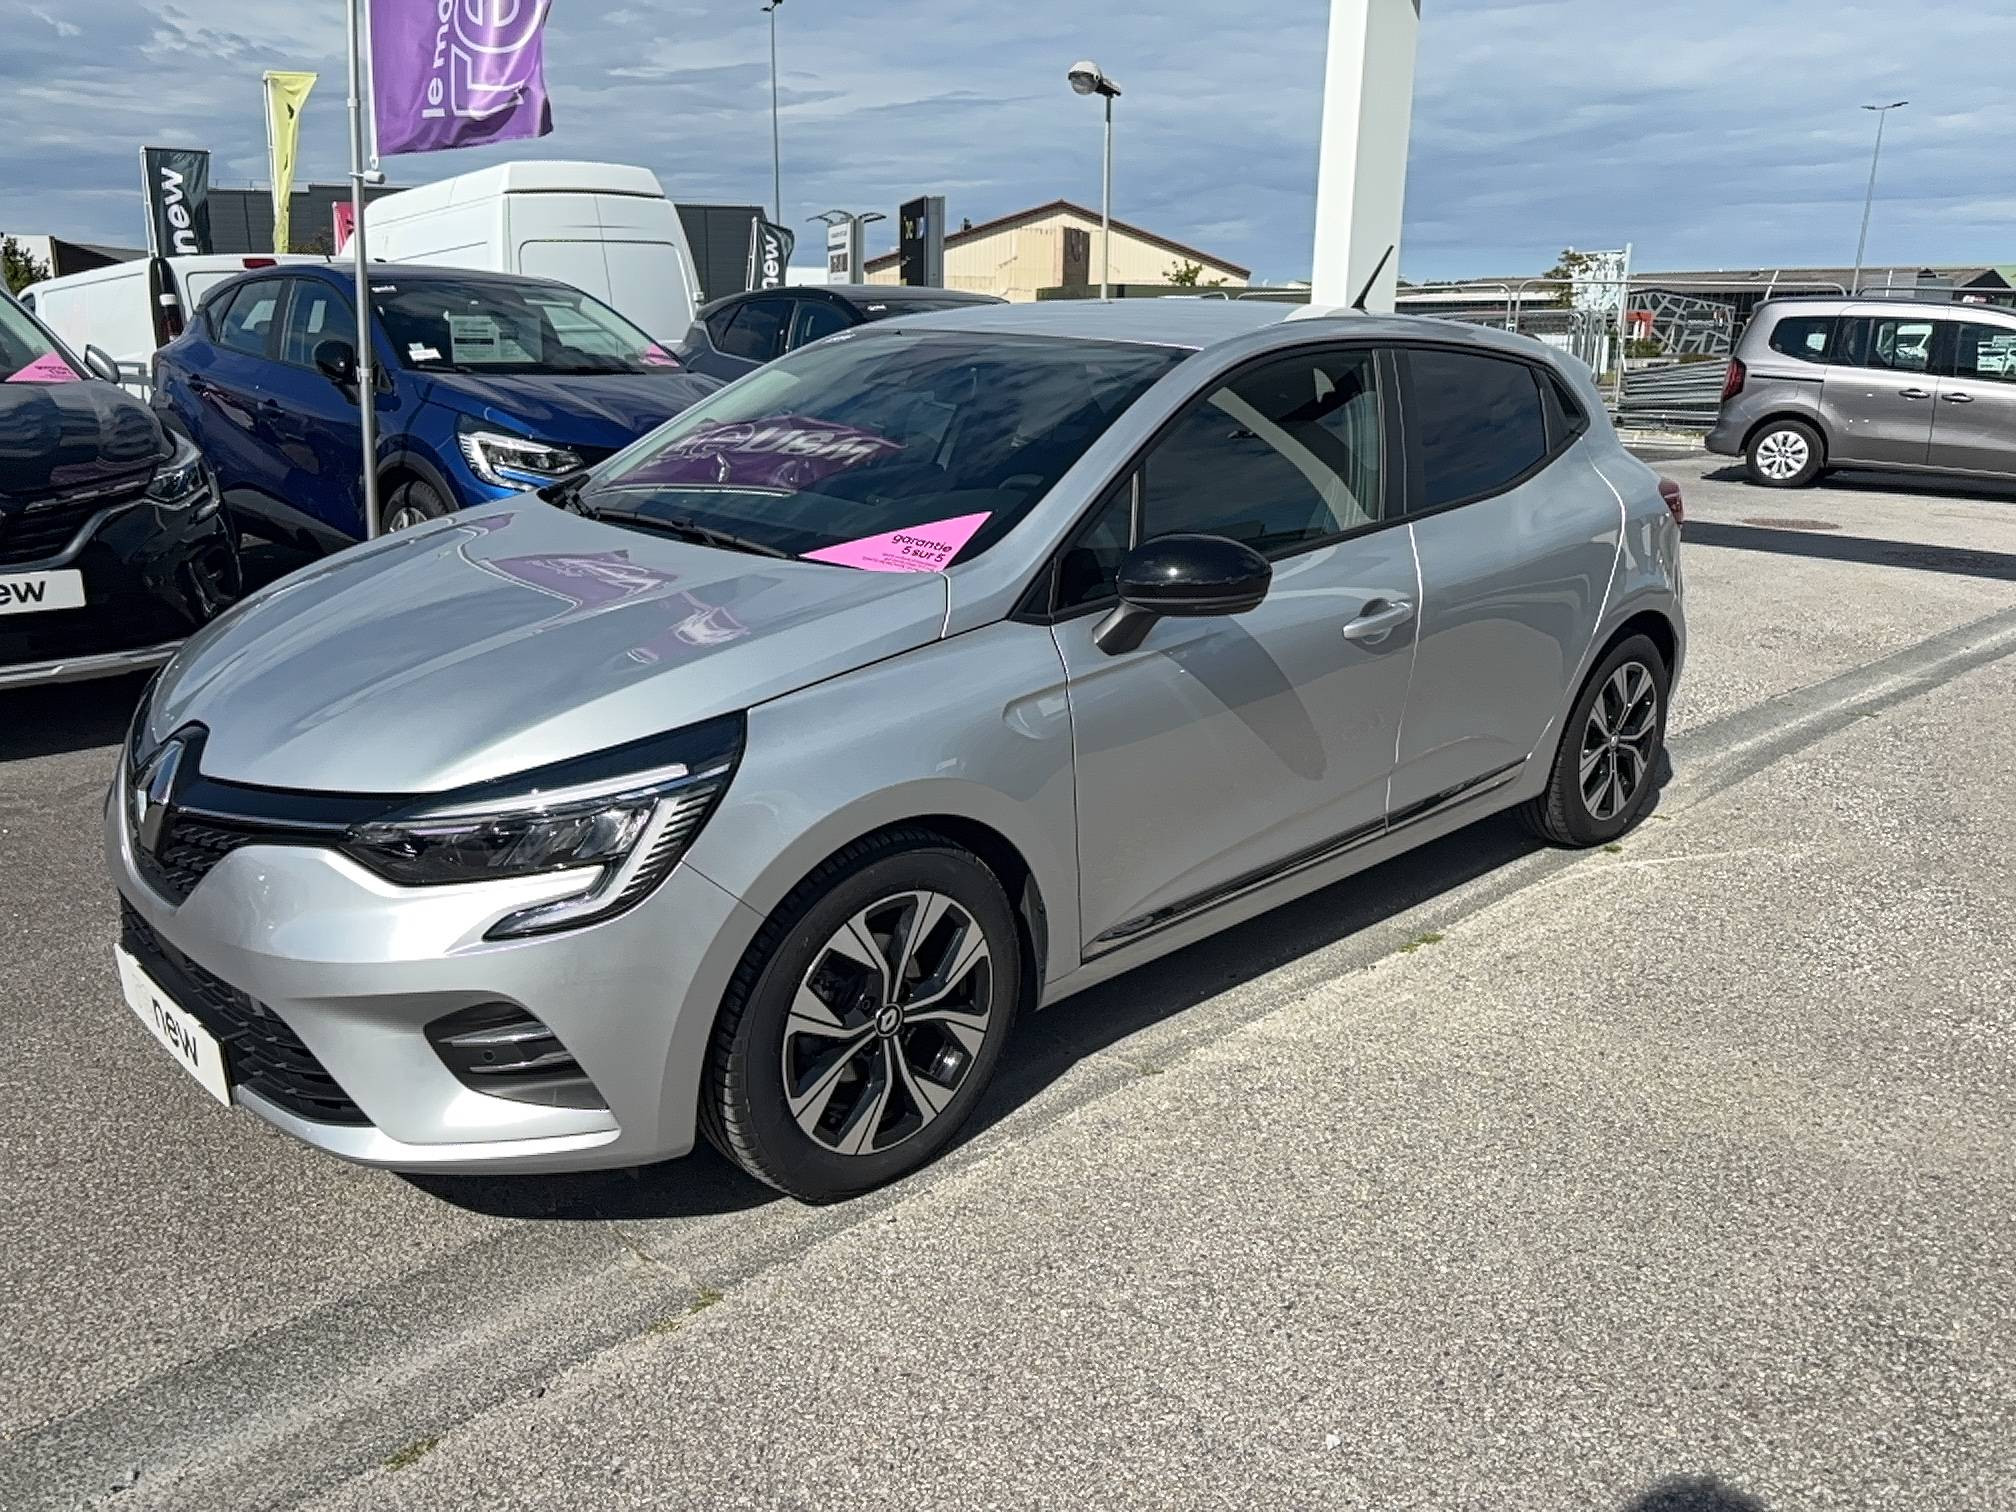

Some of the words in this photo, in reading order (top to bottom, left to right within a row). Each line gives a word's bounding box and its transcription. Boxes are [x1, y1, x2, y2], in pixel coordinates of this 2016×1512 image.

[421, 77, 447, 119] le
[161, 167, 198, 255] new
[892, 534, 953, 552] garantie
[902, 545, 912, 555] 5
[912, 549, 934, 560] sur
[934, 552, 946, 563] 5
[151, 996, 199, 1067] new
